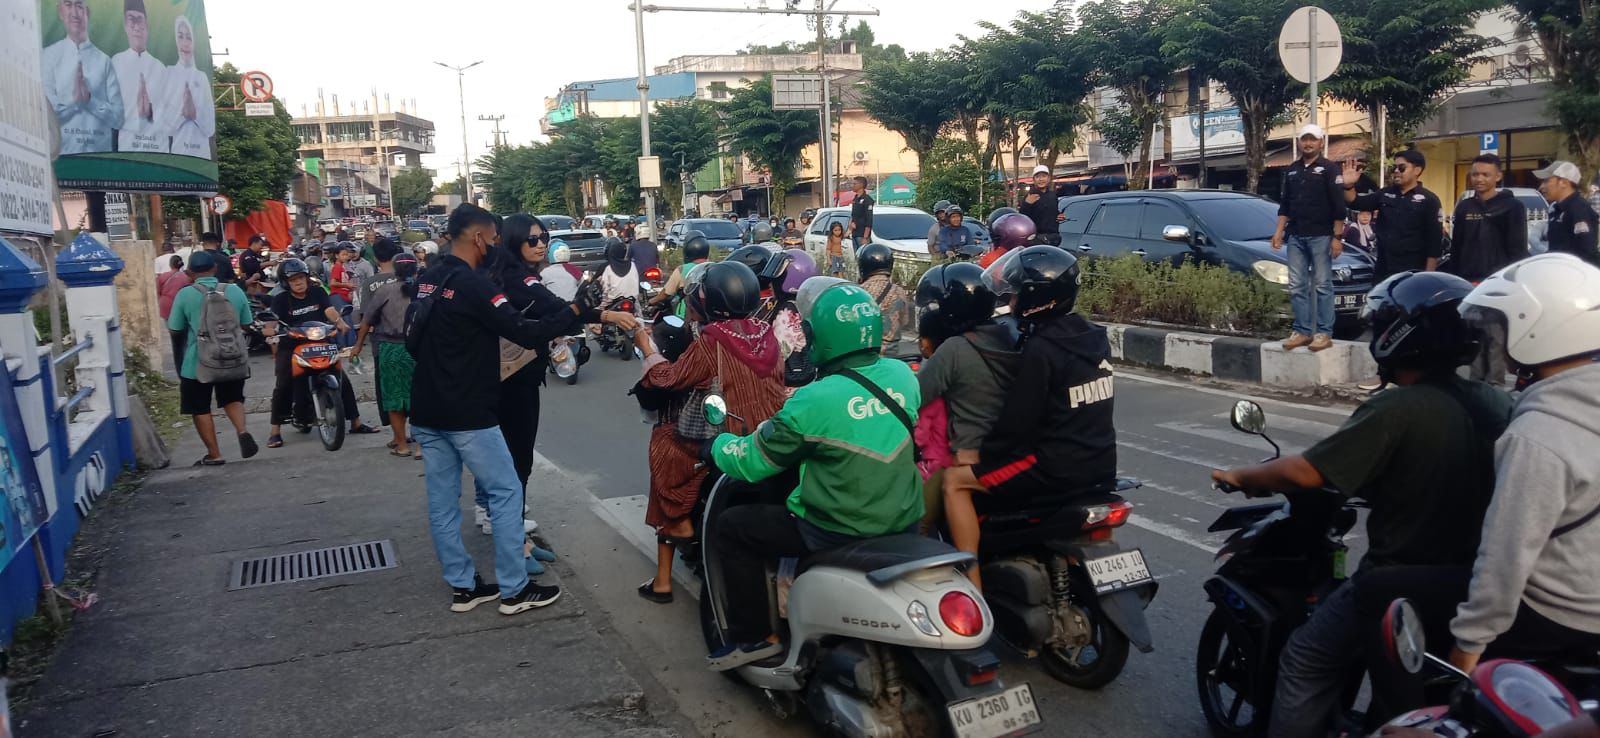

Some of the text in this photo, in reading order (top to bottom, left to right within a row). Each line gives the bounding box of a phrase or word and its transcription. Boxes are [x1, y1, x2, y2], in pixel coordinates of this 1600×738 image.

[1484, 134, 1494, 149] P
[1088, 562, 1103, 577] KU
[1104, 556, 1128, 573] 2461
[841, 616, 901, 631] SCOOPY
[953, 707, 974, 728] KU
[977, 695, 1010, 720] 2360
